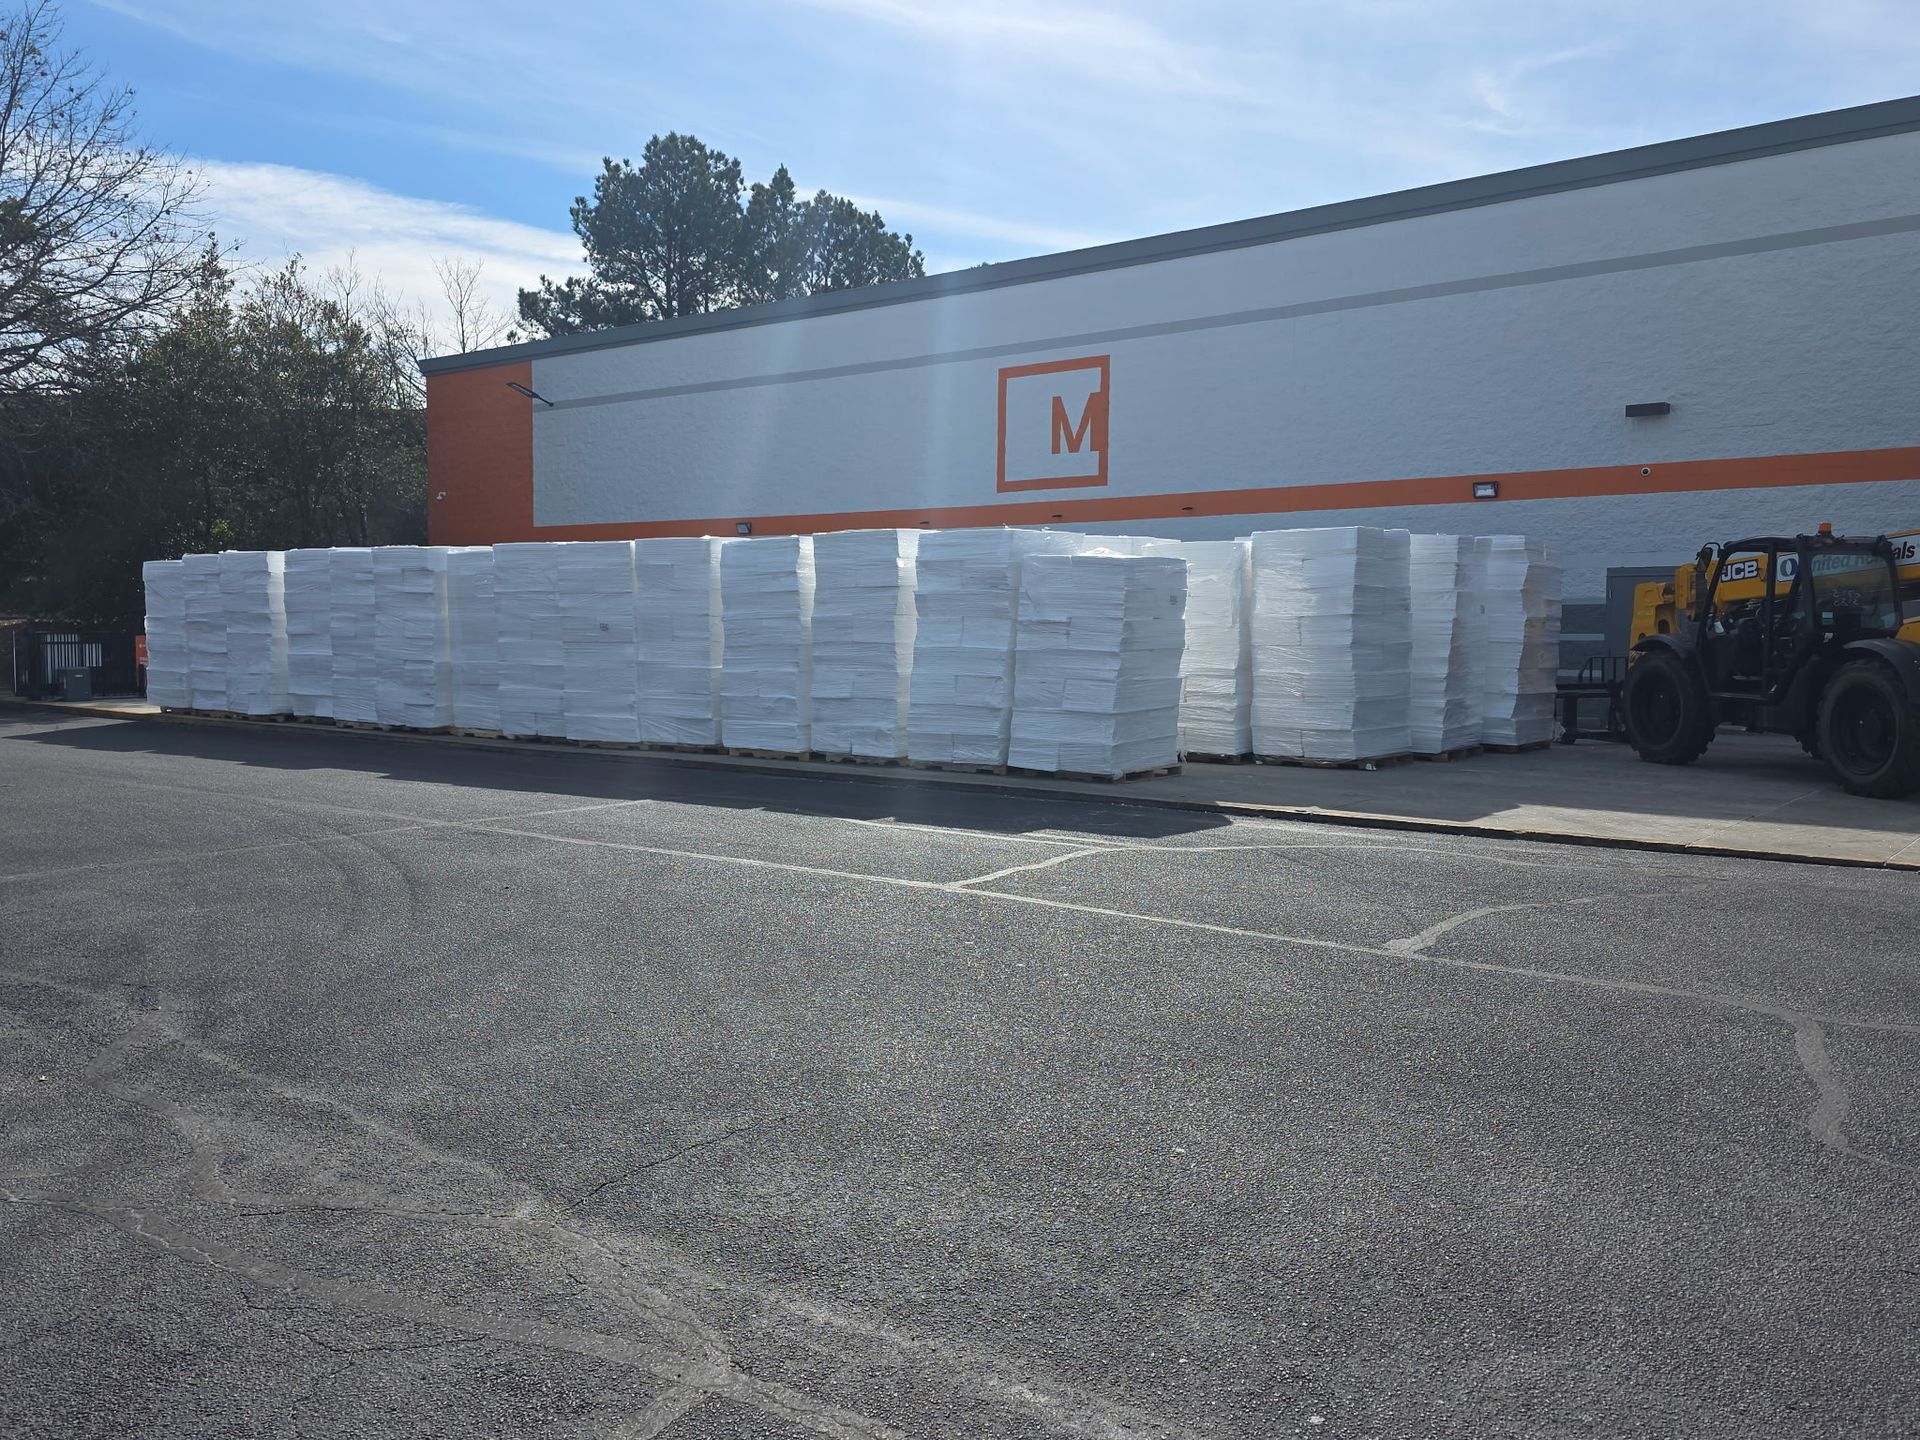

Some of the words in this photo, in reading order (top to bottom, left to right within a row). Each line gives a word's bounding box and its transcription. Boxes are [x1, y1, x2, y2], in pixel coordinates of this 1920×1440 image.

[1052, 391, 1101, 455] M
[1721, 560, 1758, 581] JCB
[1812, 554, 1850, 573] nited
